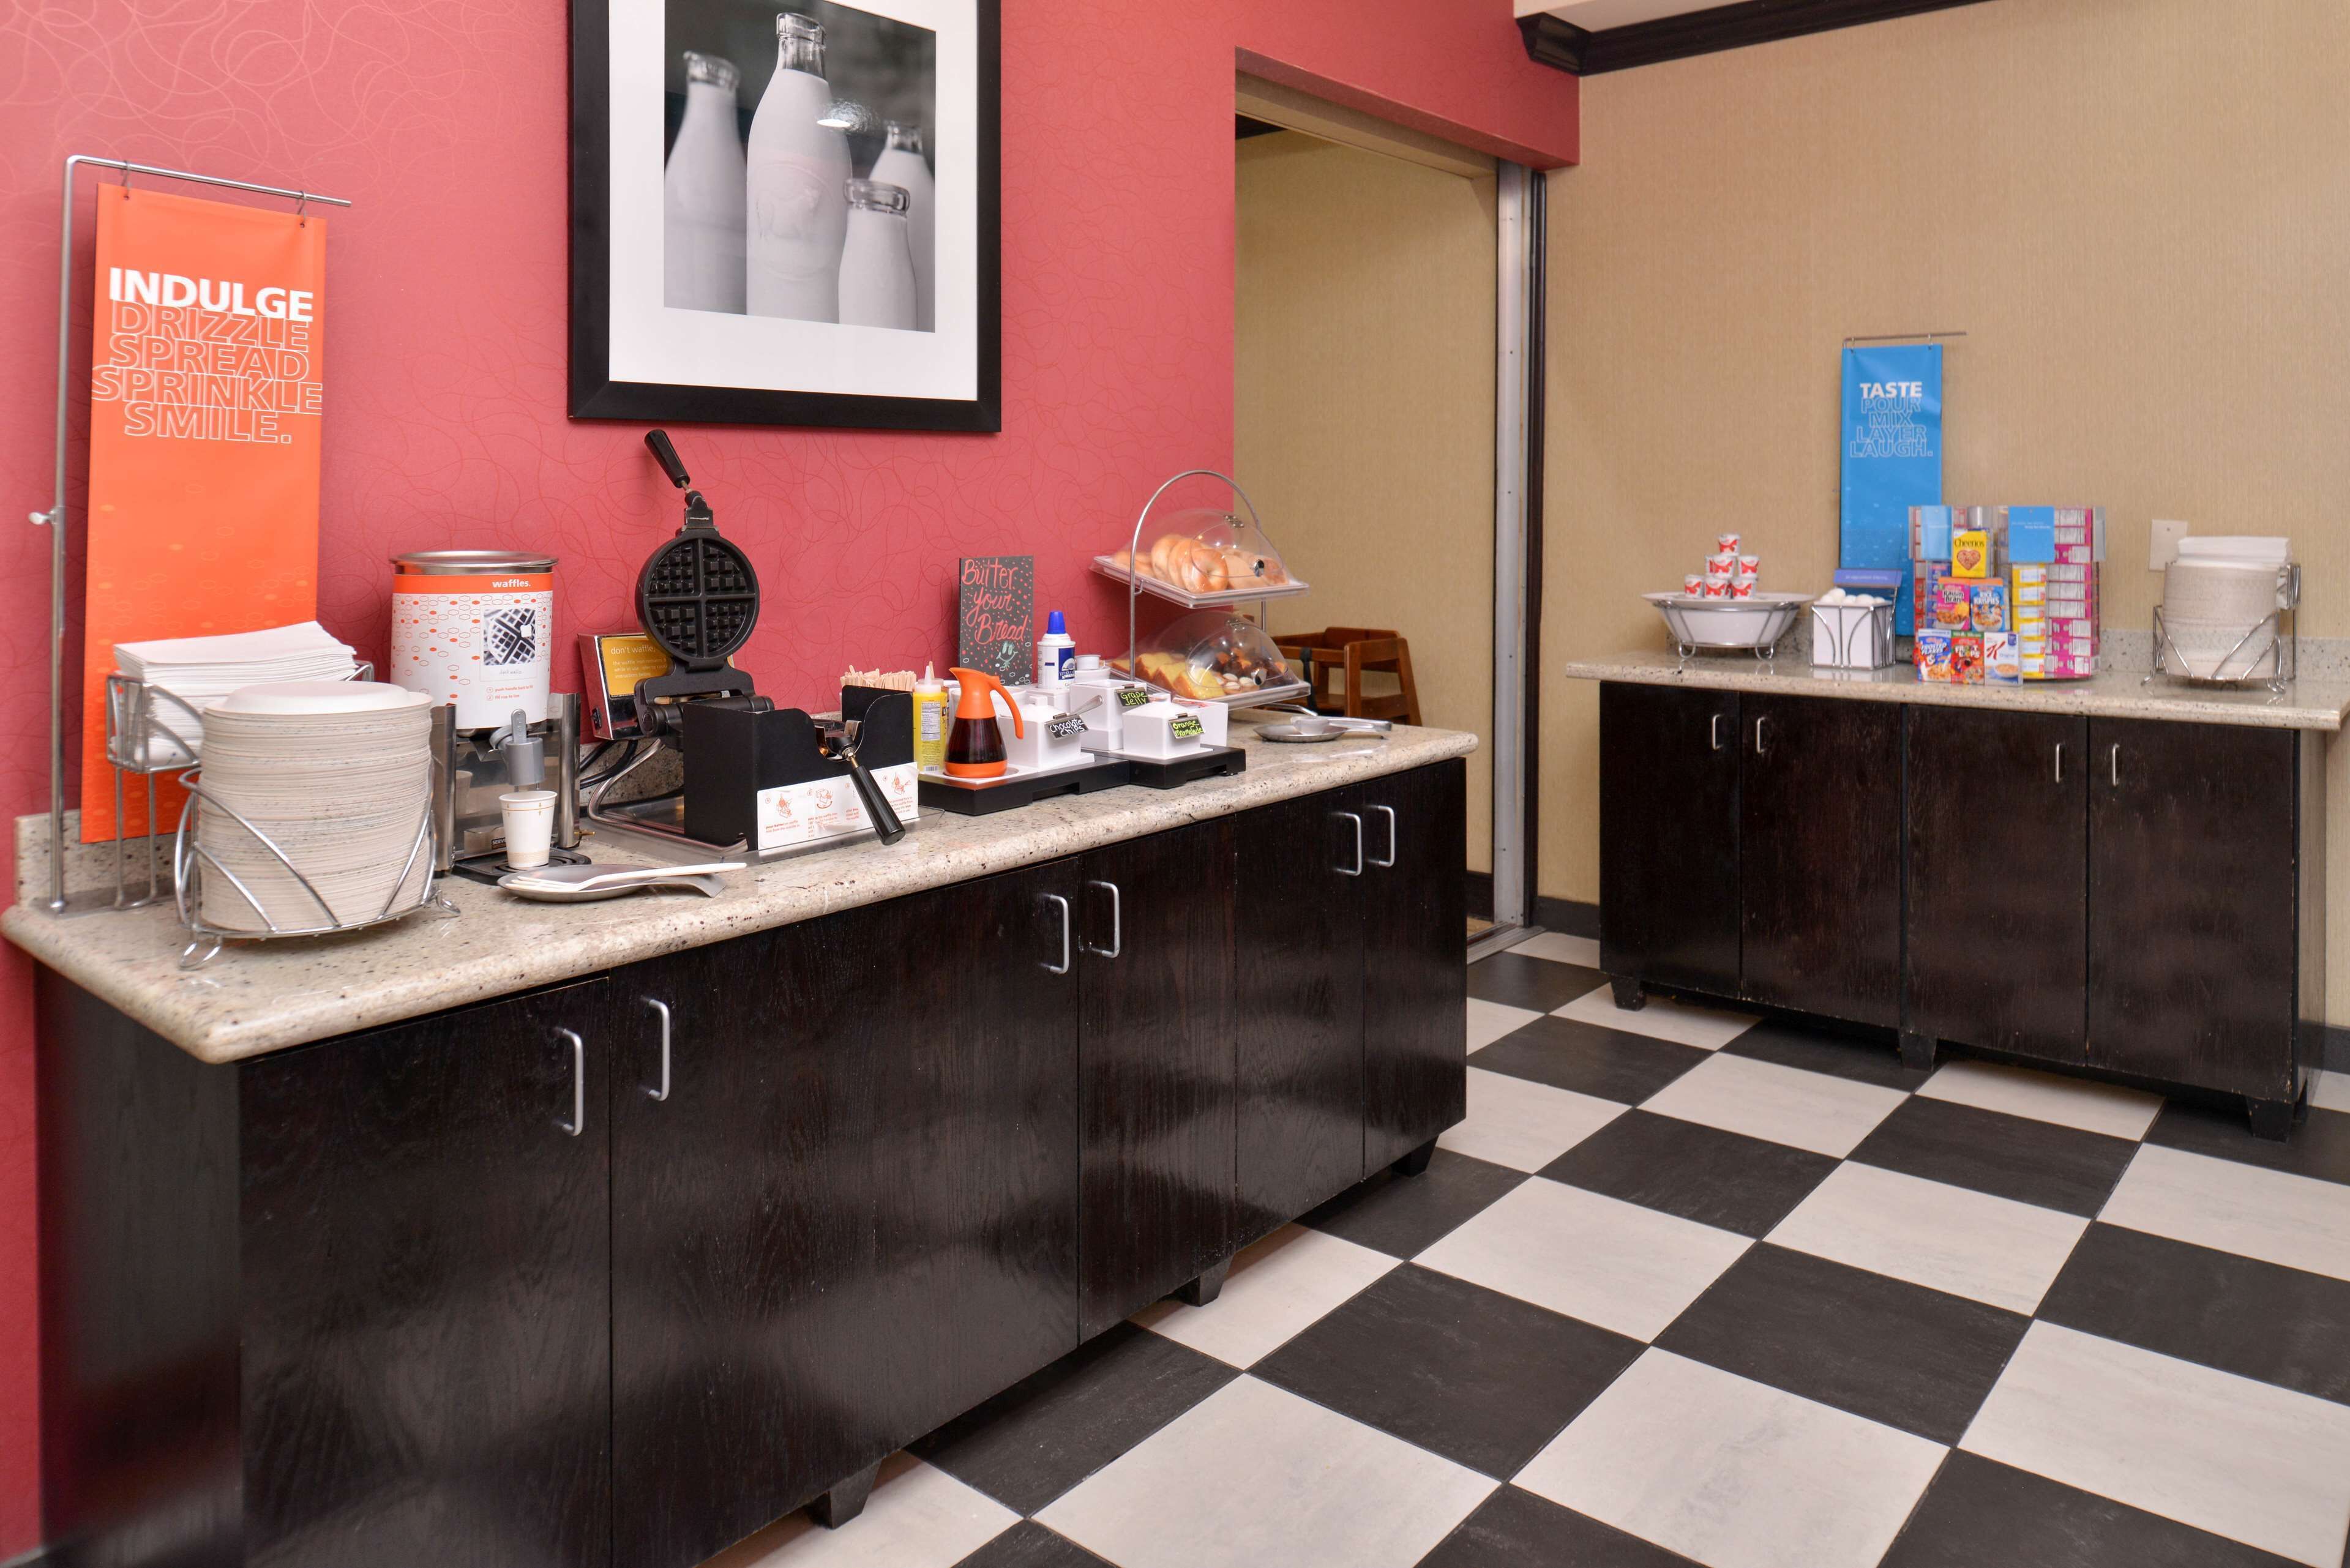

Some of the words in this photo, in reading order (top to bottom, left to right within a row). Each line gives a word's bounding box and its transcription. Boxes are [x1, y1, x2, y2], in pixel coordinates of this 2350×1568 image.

[110, 267, 313, 322] INDULGE
[112, 299, 309, 353] DRIZZLE
[109, 332, 309, 383] SPREAD
[92, 365, 323, 416] SPRINKLE
[1860, 381, 1922, 398] TASTE
[1861, 397, 1921, 414] POUR
[124, 401, 292, 444] SMILE.
[1869, 411, 1914, 428] MIX
[1857, 425, 1926, 443] LAYER
[1850, 440, 1933, 458] LAUGH.
[1955, 538, 1985, 548] Cheerios
[492, 578, 531, 588] waffles.
[962, 558, 1019, 590] Butter
[967, 587, 1013, 627] your
[975, 614, 1028, 645] Bread
[1125, 697, 1147, 706] Jelly
[1172, 720, 1200, 730] Orange
